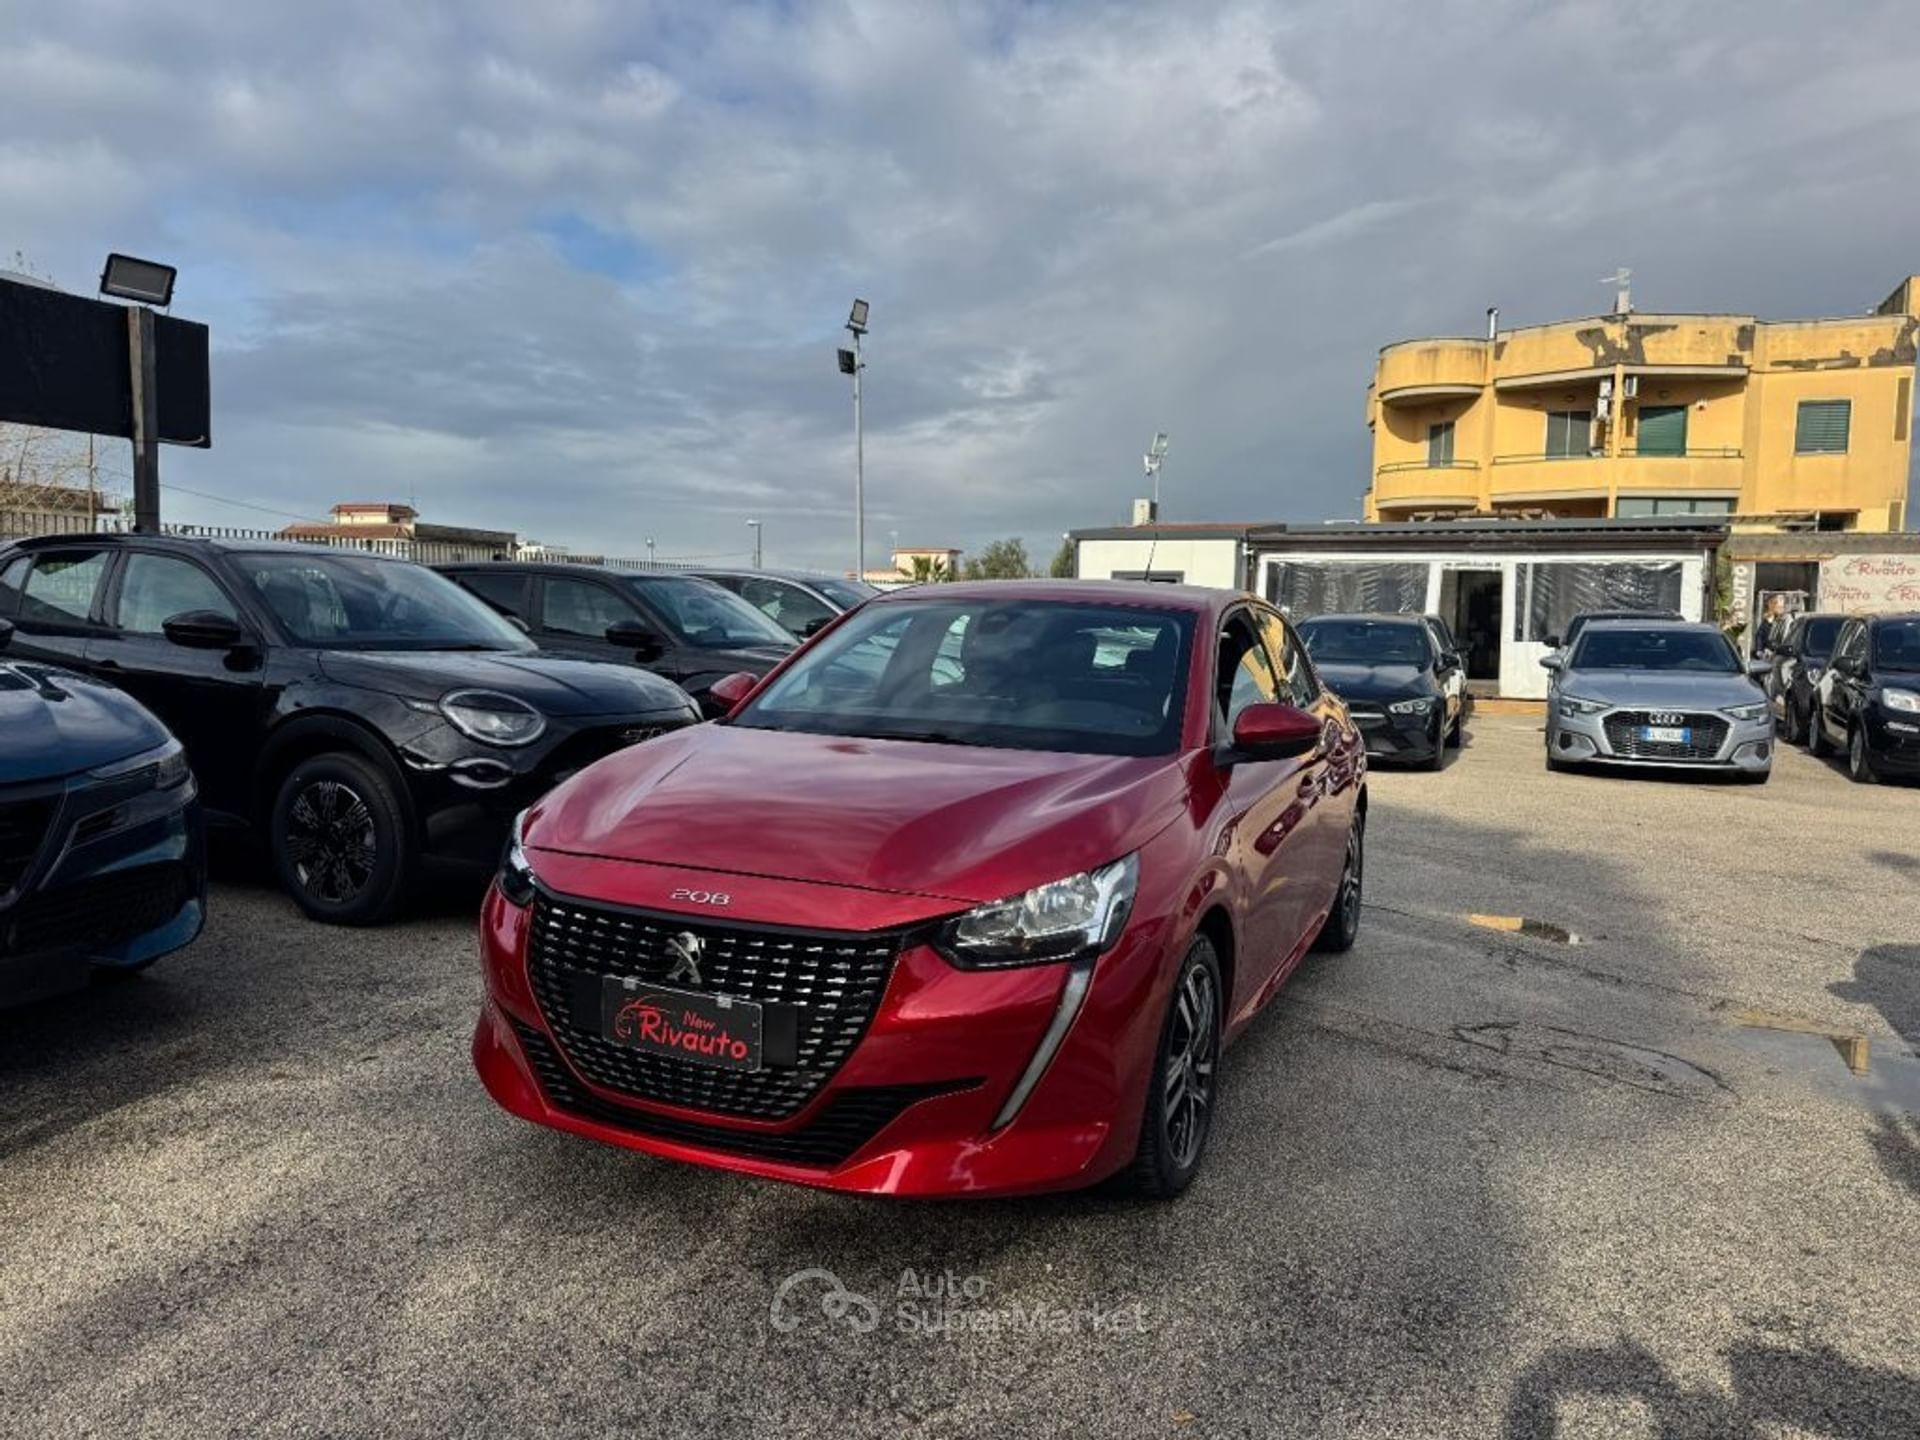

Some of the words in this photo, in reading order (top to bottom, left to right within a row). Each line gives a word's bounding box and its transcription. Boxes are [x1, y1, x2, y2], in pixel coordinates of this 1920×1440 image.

[1859, 562, 1915, 575] Rivauto
[671, 888, 731, 905] 208
[682, 1010, 717, 1030] New
[638, 1010, 748, 1058] Rivauto
